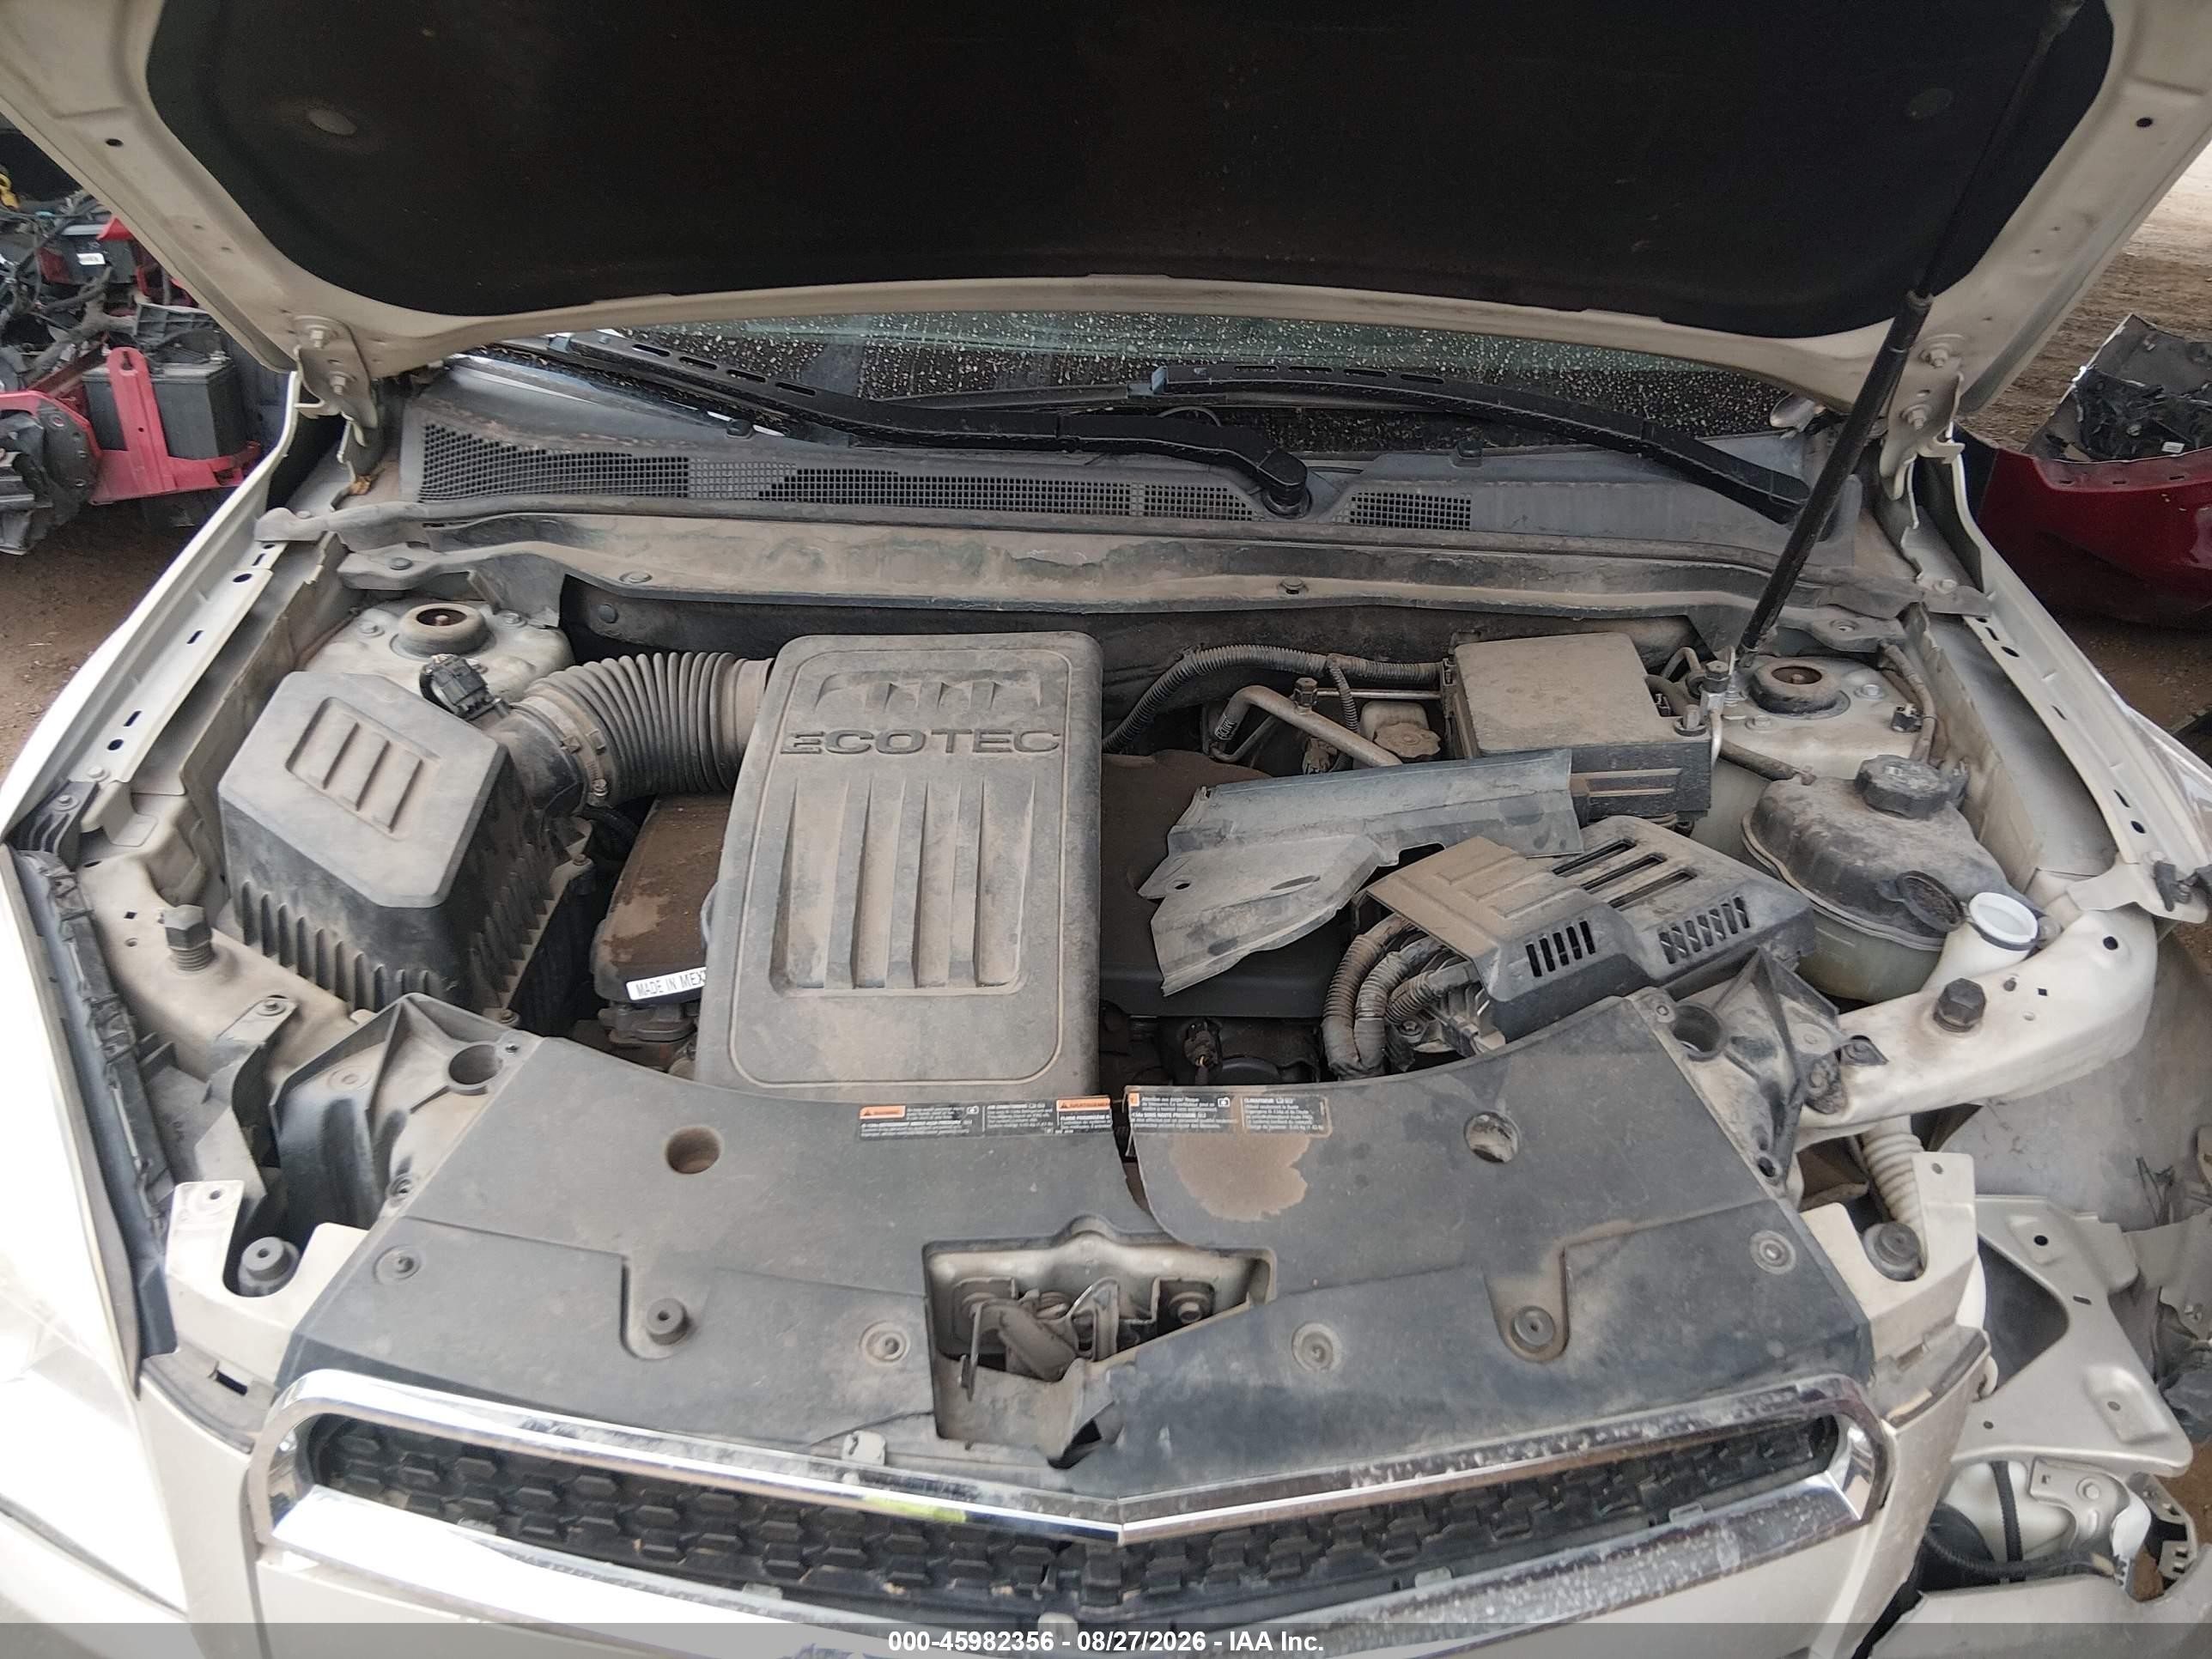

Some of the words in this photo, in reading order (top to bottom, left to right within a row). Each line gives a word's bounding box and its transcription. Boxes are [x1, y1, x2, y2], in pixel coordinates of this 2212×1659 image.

[780, 729, 1061, 756] ECOTEC
[635, 980, 664, 997] MADE
[665, 977, 678, 992] IN
